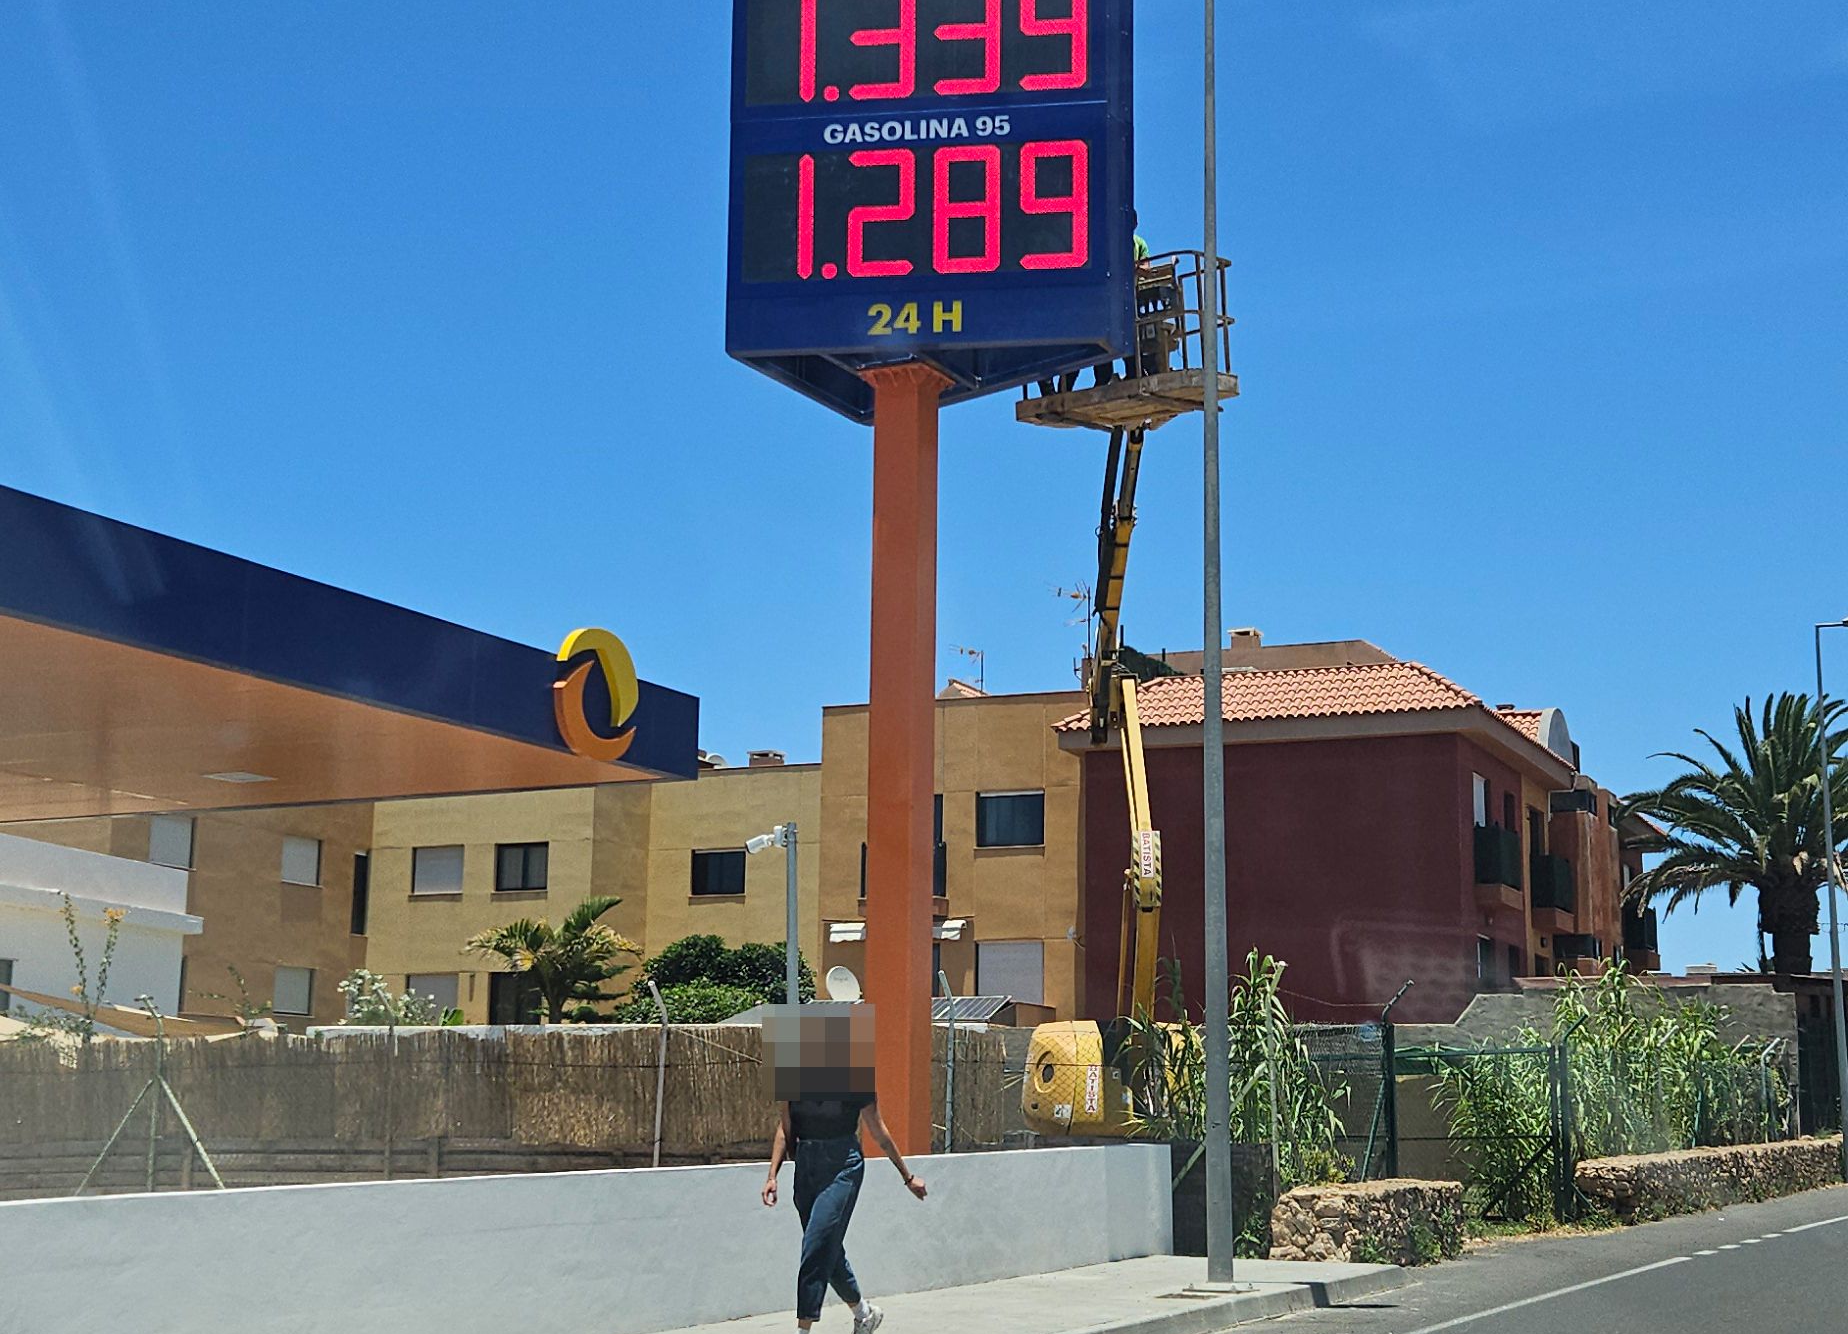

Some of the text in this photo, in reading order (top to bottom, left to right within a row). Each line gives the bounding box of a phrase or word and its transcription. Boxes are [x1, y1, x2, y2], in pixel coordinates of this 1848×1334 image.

[823, 115, 1011, 144] GASOLINA 95
[797, 139, 1089, 280] 1.289
[867, 300, 962, 335] 24 H
[1142, 832, 1152, 876] BATISTA
